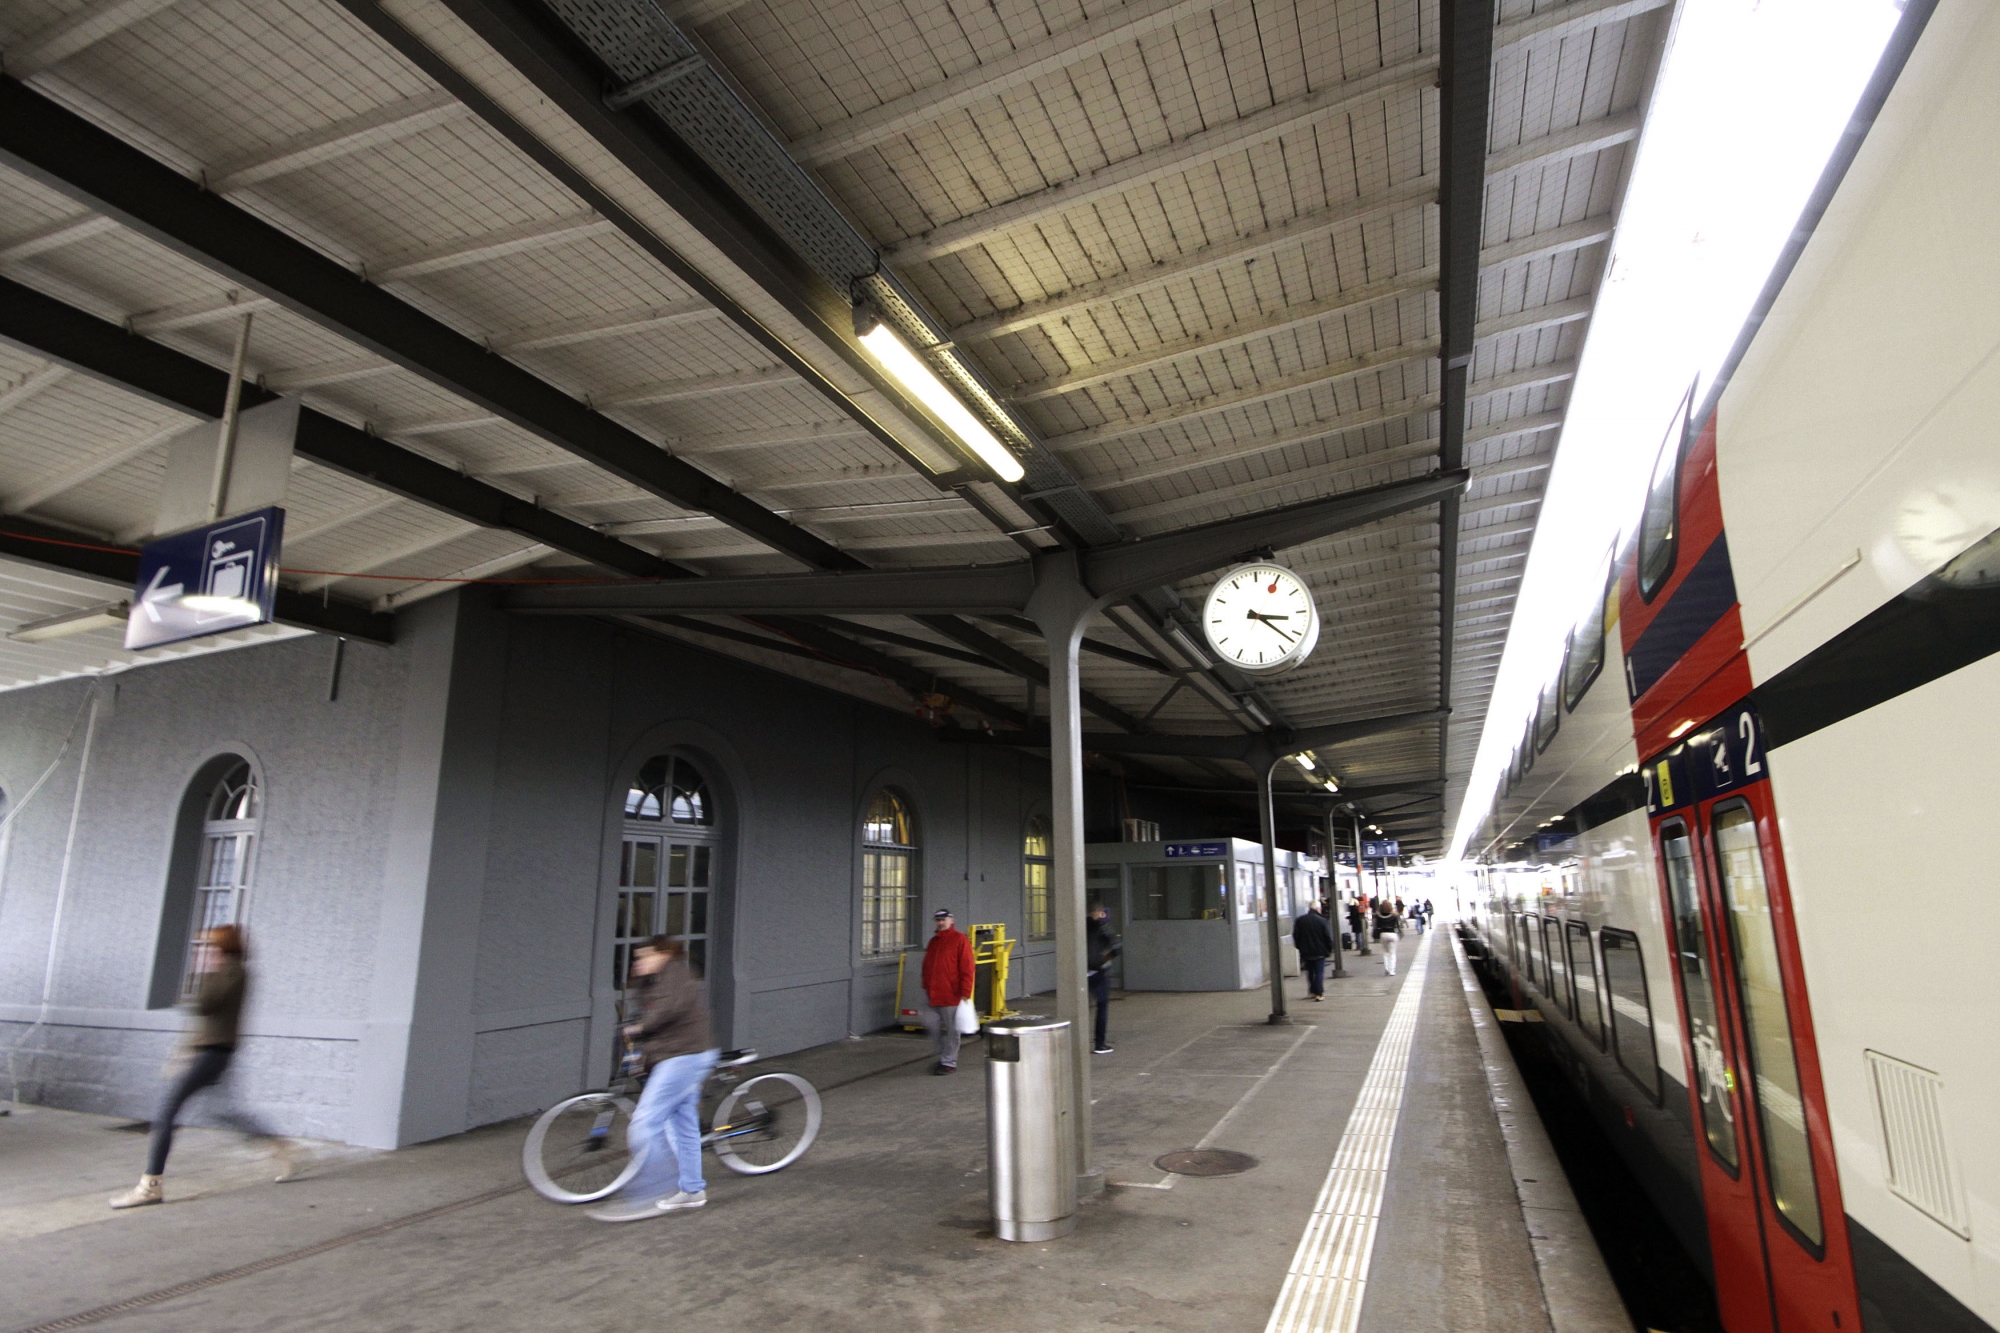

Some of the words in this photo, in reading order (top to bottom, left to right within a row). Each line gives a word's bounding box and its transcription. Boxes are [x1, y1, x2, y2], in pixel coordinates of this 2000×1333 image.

[1627, 656, 1637, 697] 1
[1739, 711, 1761, 776] 2
[1367, 846, 1376, 855] B
[1385, 845, 1392, 854] 1
